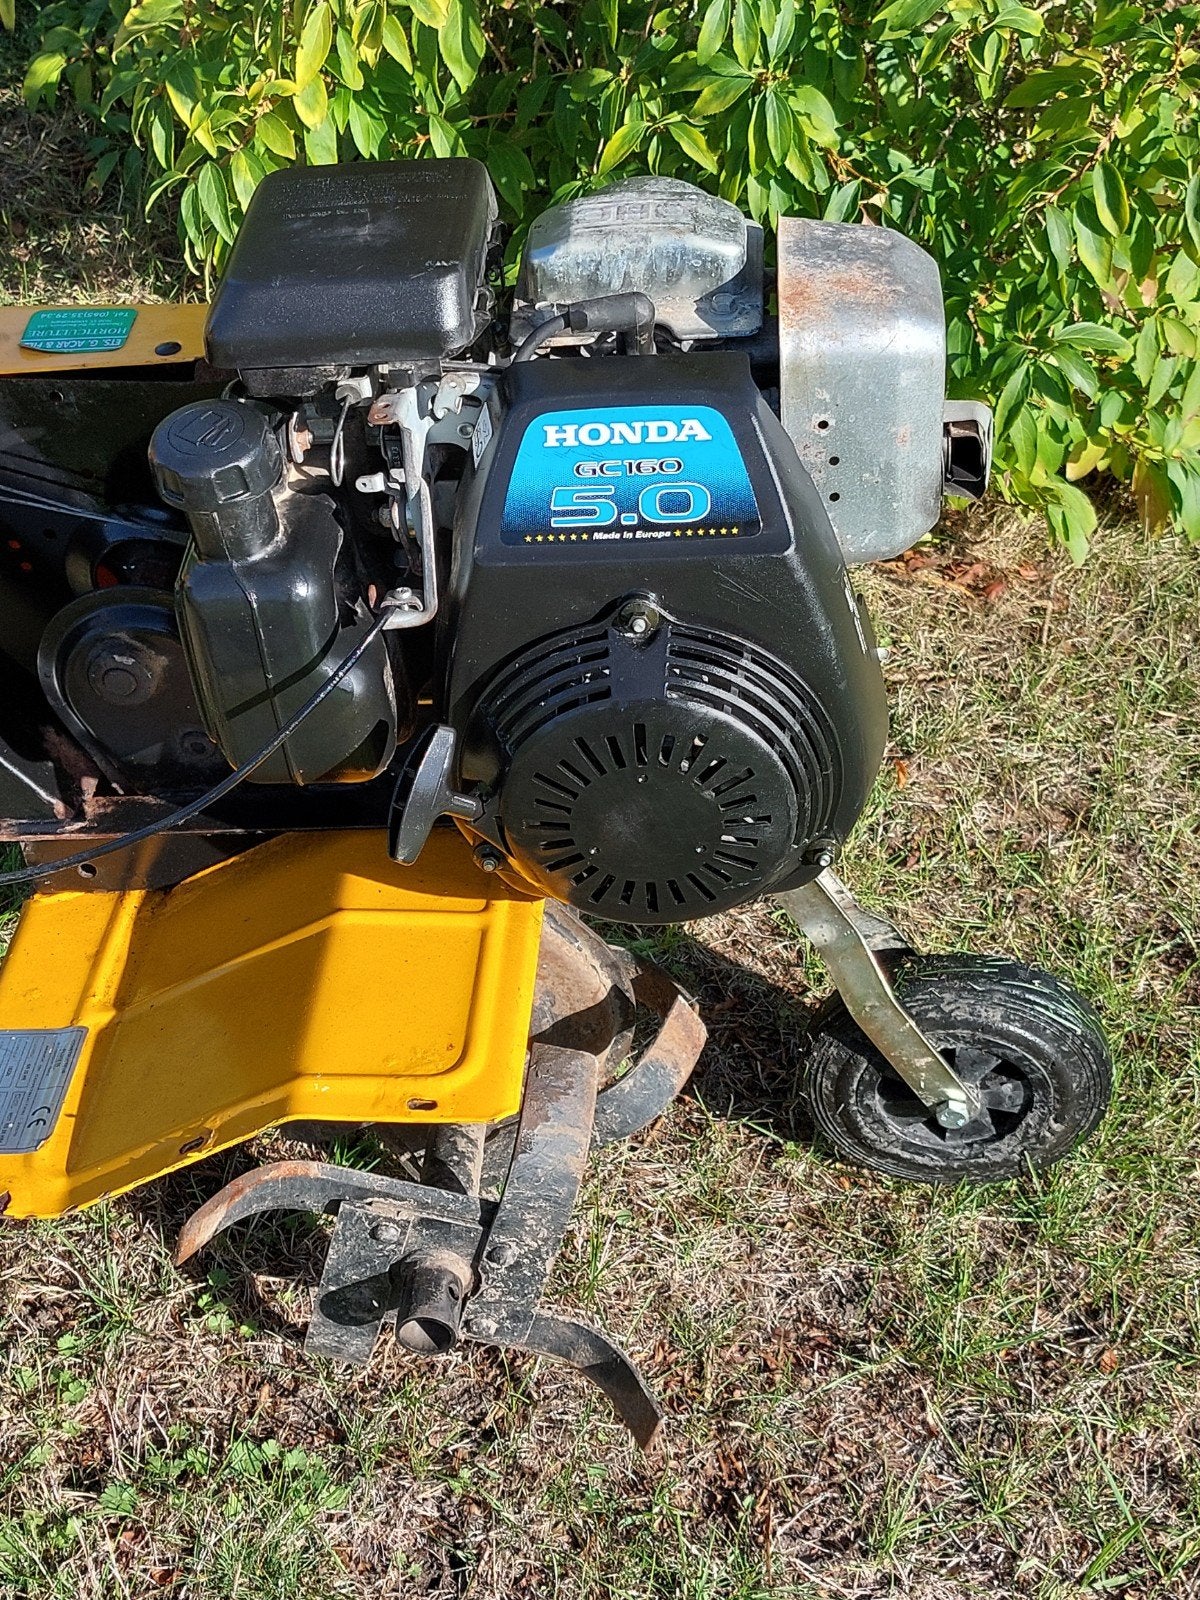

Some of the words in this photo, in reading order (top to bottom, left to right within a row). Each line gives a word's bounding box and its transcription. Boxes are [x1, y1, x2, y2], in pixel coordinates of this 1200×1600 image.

[28, 327, 128, 338] HORTICULTURE
[56, 340, 85, 349] ACAR
[103, 339, 122, 347] ETS.
[543, 419, 712, 447] HONDA
[574, 457, 684, 477] GC160
[550, 482, 711, 527] 5.0
[593, 531, 620, 540] Made
[623, 530, 632, 539] in
[635, 529, 671, 540] Europe
[27, 1105, 51, 1129] CE
